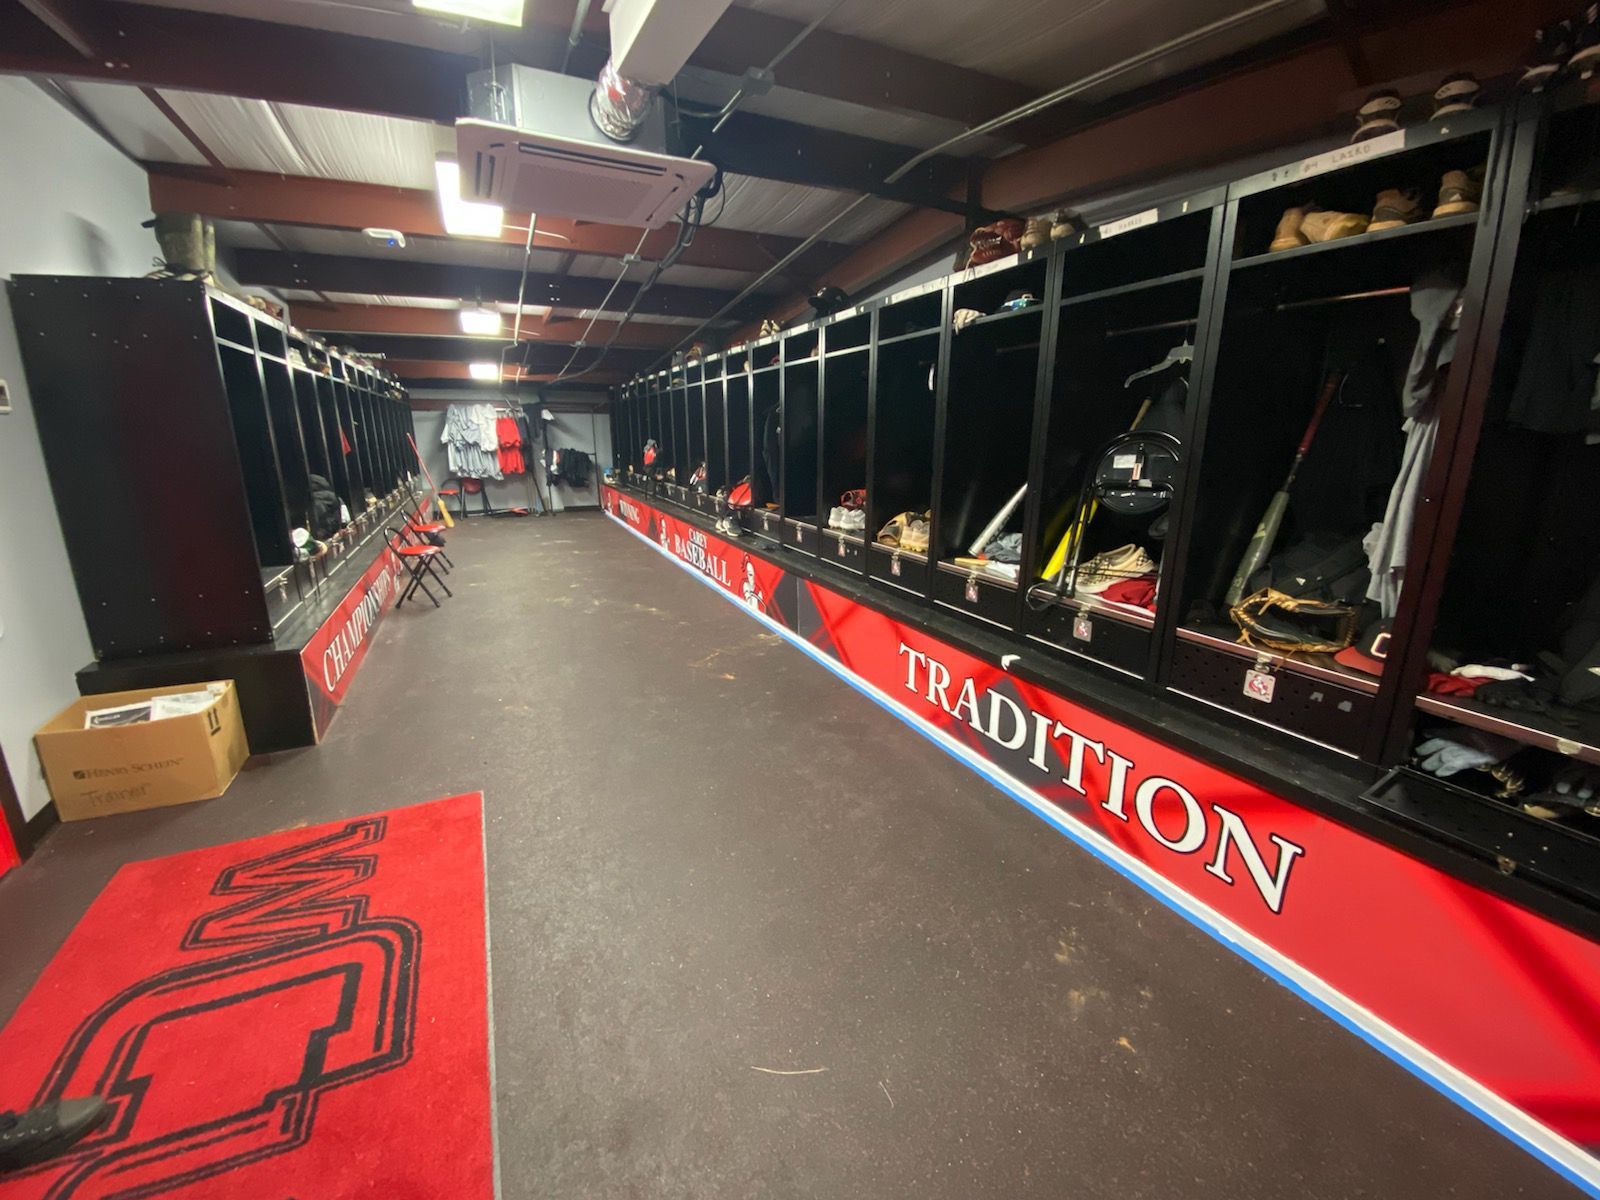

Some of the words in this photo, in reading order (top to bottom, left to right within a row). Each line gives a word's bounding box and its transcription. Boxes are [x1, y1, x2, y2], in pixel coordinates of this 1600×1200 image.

[674, 533, 731, 587] BASEBALL
[86, 765, 128, 780] HENRY
[898, 642, 1305, 914] TRADITION
